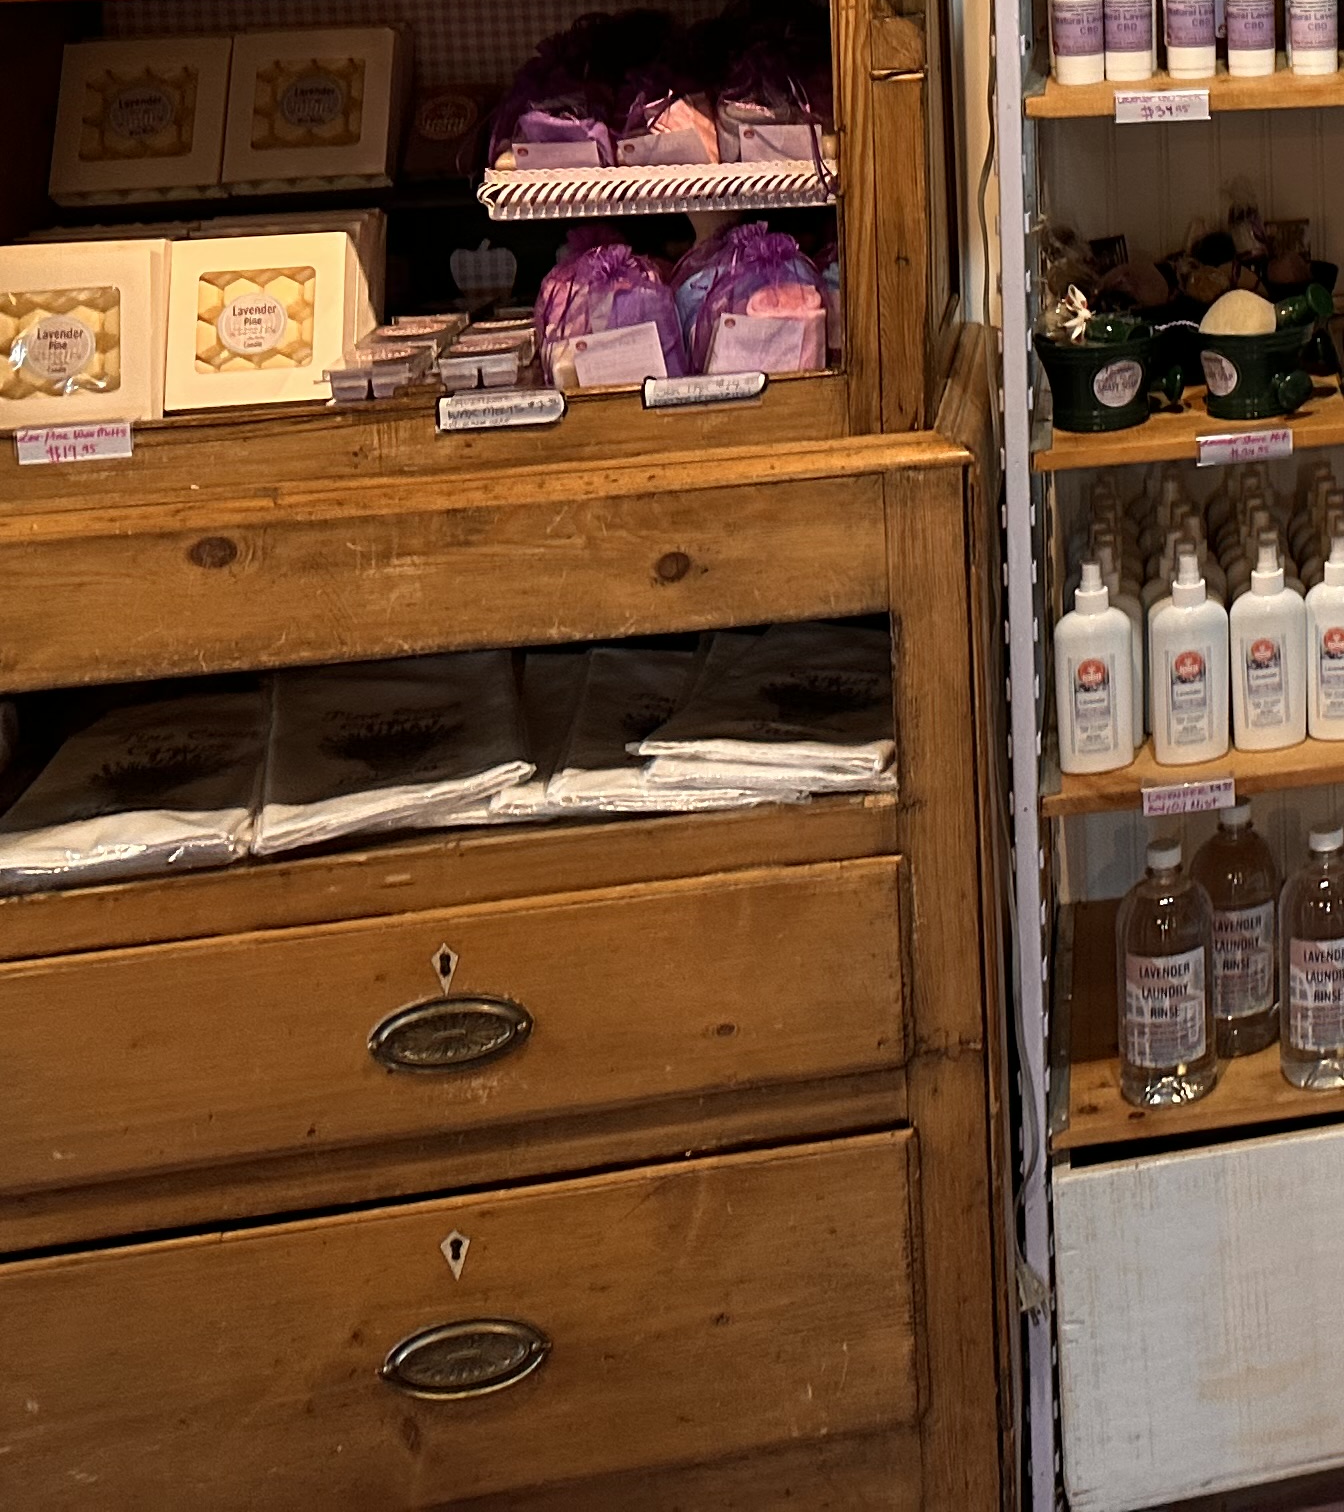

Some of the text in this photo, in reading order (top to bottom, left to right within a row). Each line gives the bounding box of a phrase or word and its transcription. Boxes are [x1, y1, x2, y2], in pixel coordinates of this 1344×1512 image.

[1116, 23, 1138, 32] CBD
[1243, 21, 1265, 30] CBD
[1307, 22, 1328, 31] CBD
[231, 303, 277, 317] Lavender
[244, 317, 262, 326] Pine
[36, 327, 84, 340] Lavender
[48, 340, 68, 350] Pine
